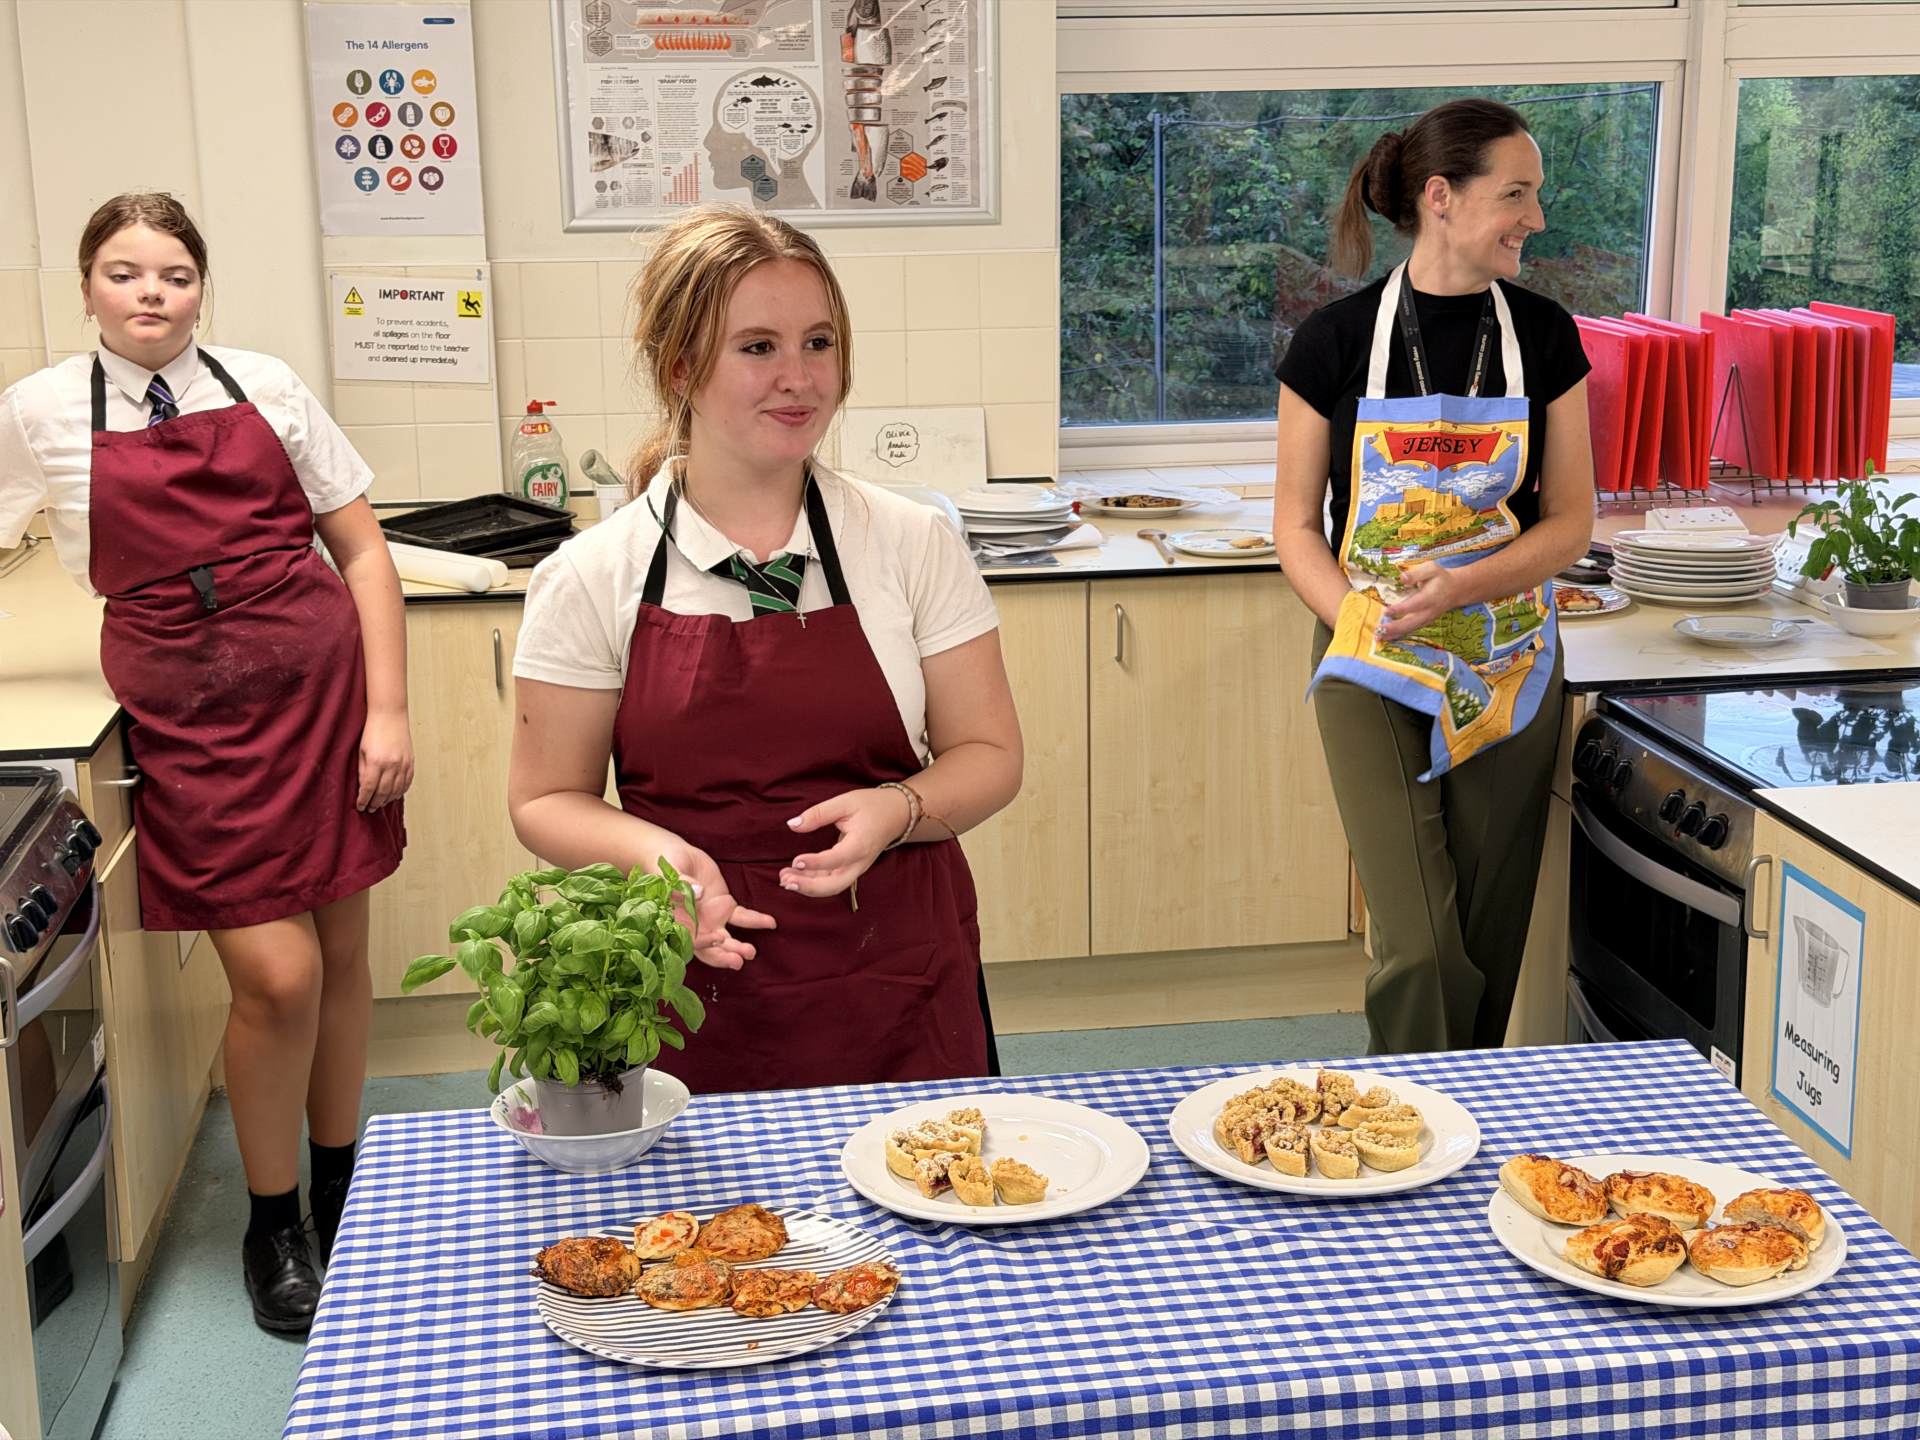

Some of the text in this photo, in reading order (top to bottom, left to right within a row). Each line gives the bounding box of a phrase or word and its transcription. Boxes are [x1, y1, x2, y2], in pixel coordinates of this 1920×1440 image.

[346, 40, 428, 52] The 14 Allergens
[379, 289, 445, 302] IMPORTANT
[376, 317, 449, 328] To prevent accidents,
[382, 330, 409, 340] spillages
[422, 331, 433, 339] the
[435, 331, 452, 339] floor
[354, 342, 375, 350] MUST
[388, 343, 419, 351] reported
[444, 344, 471, 352] teacher
[368, 354, 458, 366] and cleaned up immediately
[1403, 435, 1484, 454] JERSEY
[532, 482, 559, 496] FAIRY
[1784, 1020, 1841, 1084] Measuring
[1796, 1070, 1822, 1106] Jugs
